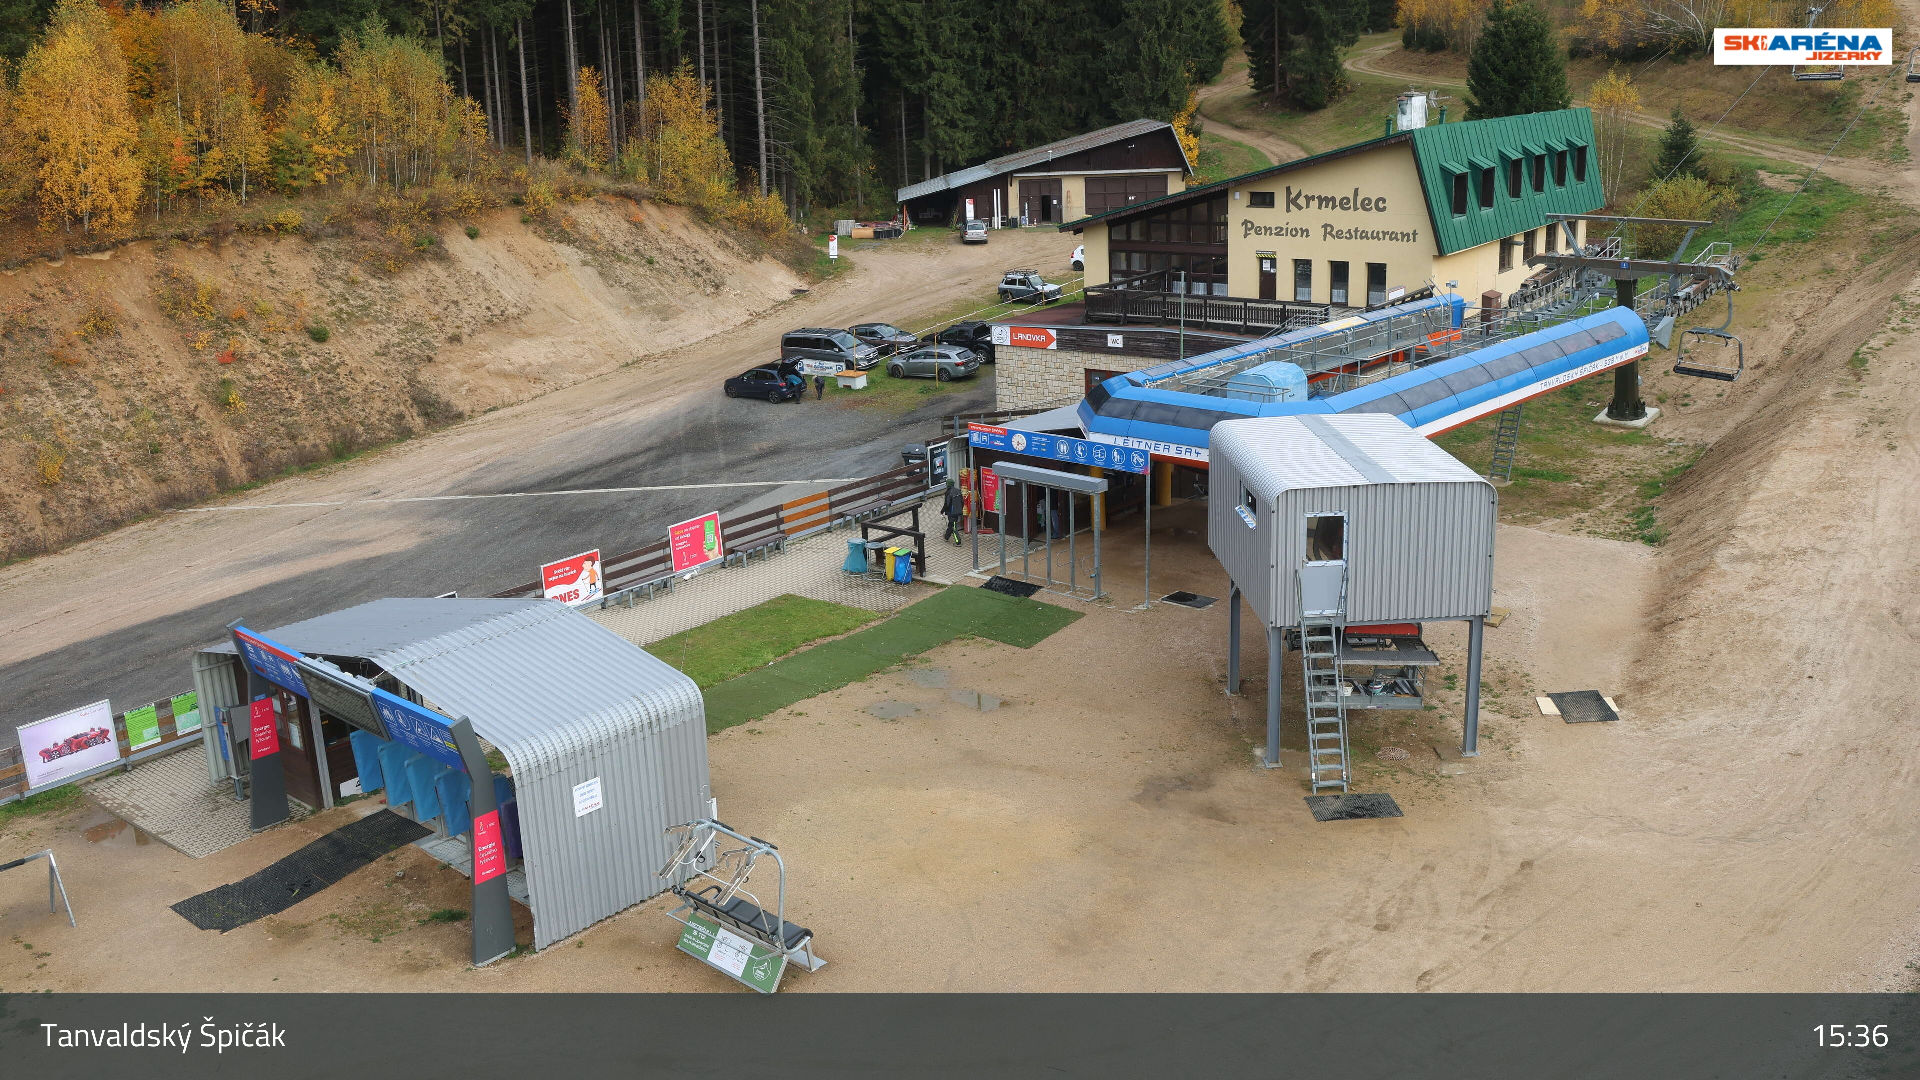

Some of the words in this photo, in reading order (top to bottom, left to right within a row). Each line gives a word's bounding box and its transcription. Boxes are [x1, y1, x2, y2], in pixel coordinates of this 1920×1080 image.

[1285, 185, 1387, 213] Krmelec
[1241, 219, 1310, 239] Penzion
[1321, 222, 1419, 243] Restaurant
[1012, 332, 1046, 342] LANOVKA
[1113, 437, 1171, 453] LEITNER
